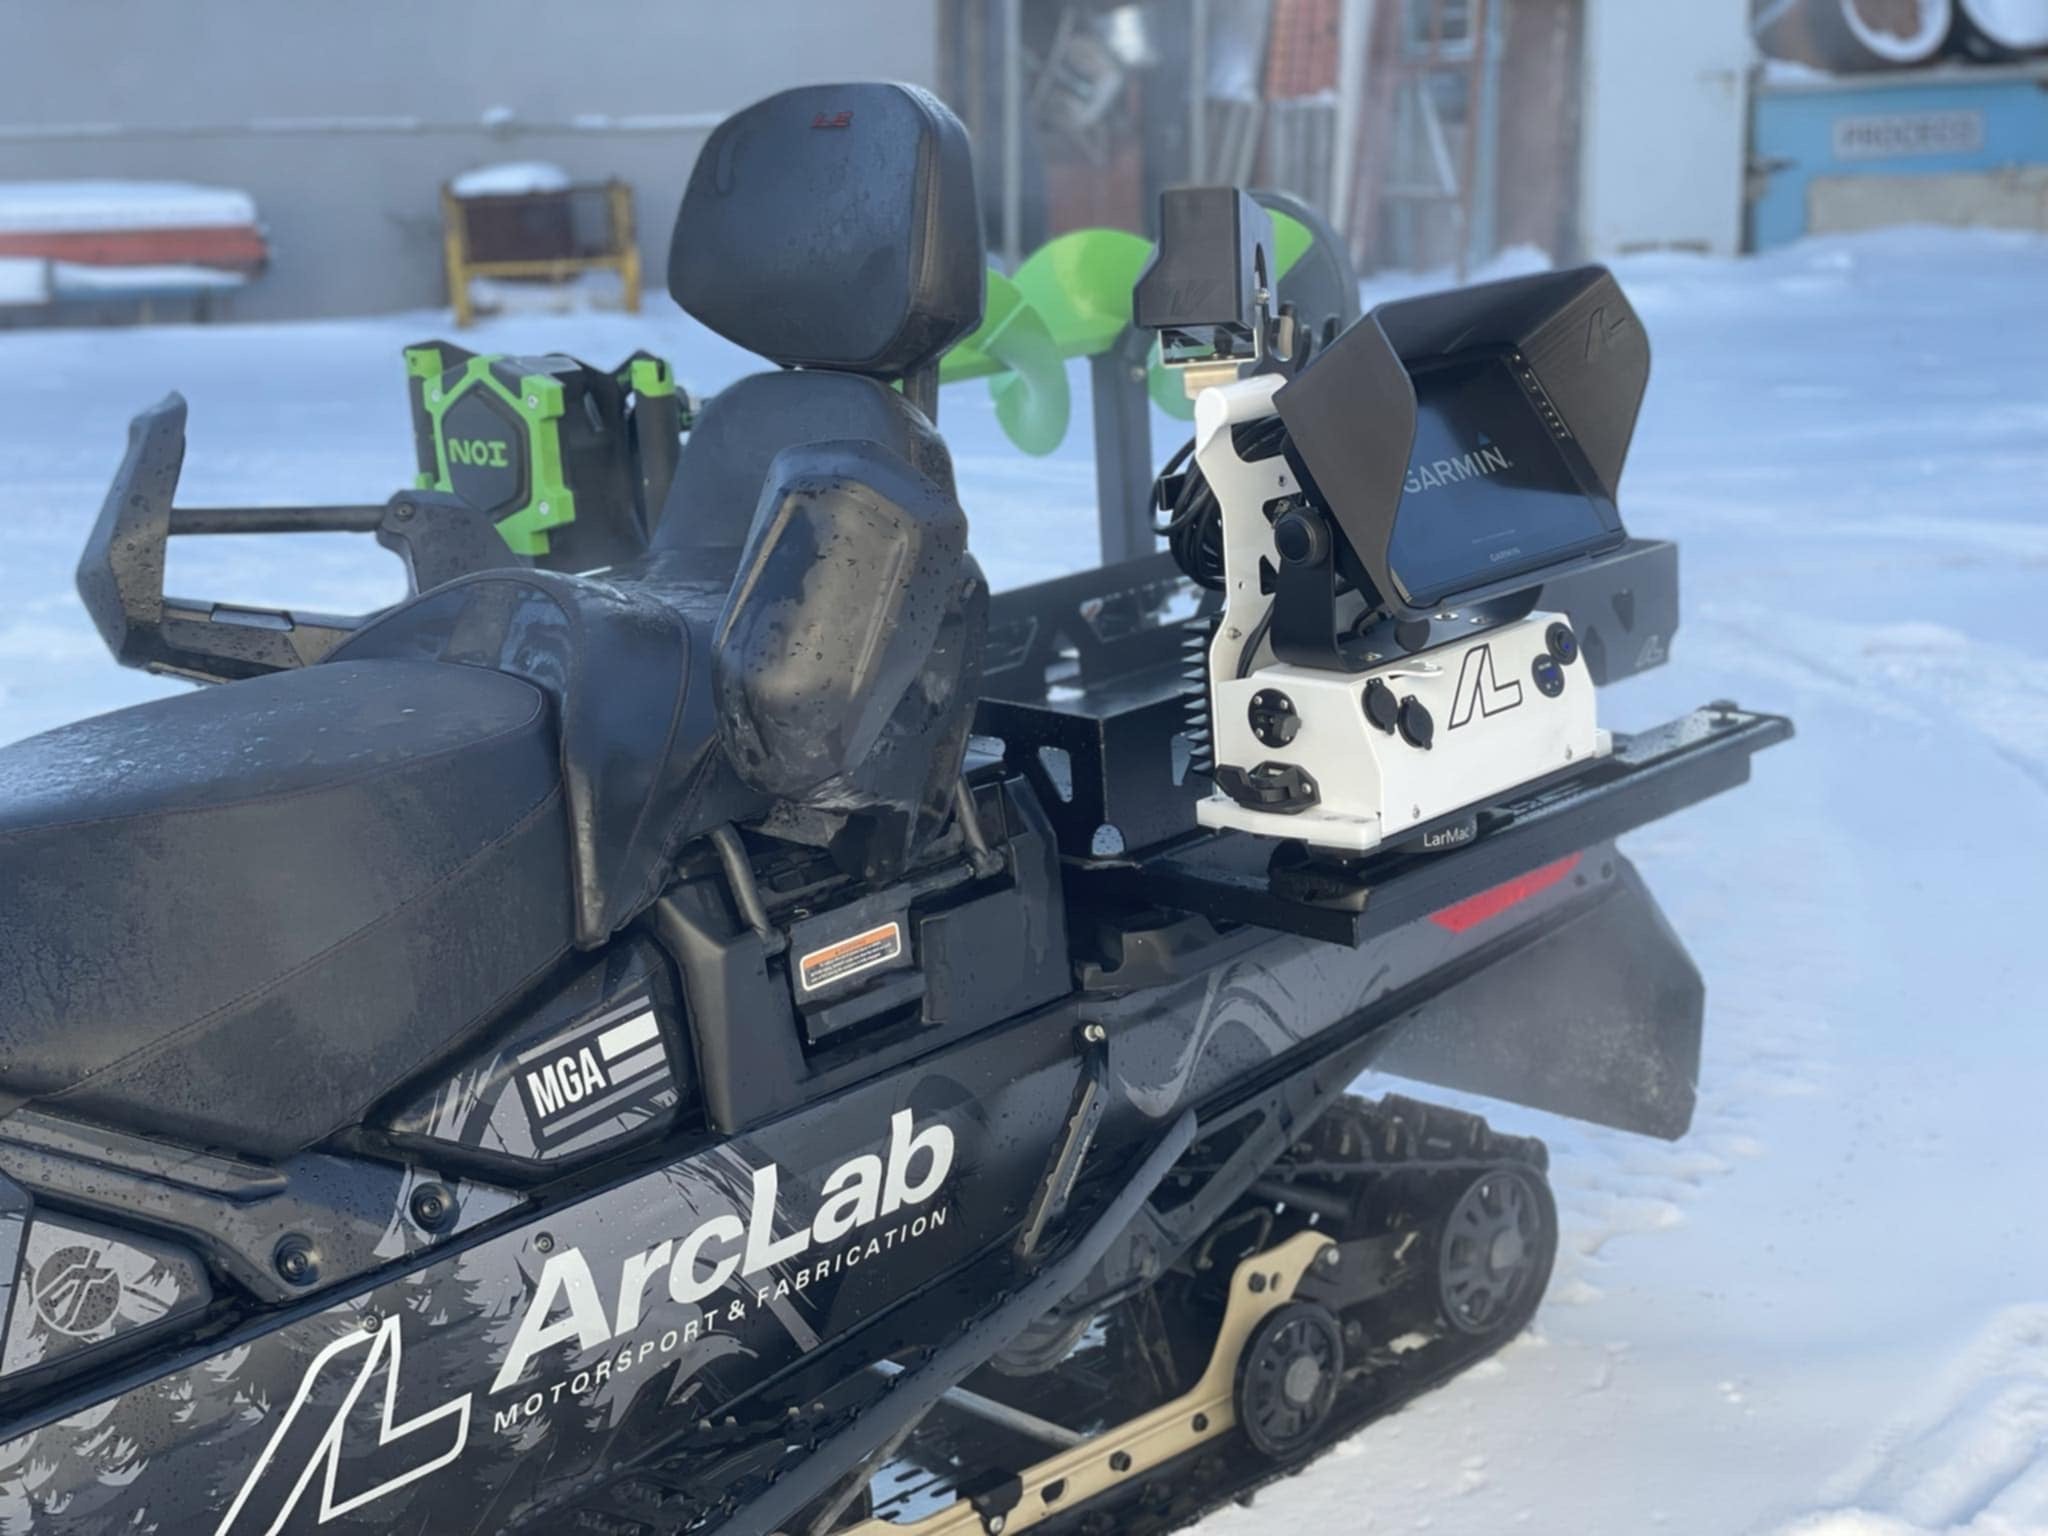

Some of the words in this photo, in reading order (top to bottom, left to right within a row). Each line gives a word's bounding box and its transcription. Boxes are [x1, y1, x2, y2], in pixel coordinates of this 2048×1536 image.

[1403, 446, 1508, 493] GARMIN
[526, 1047, 606, 1119] MGA
[489, 1108, 955, 1394] ArcLab
[493, 1309, 719, 1433] MOTORSPORT
[727, 1300, 746, 1321] &
[756, 1207, 948, 1309] FABRICATION
